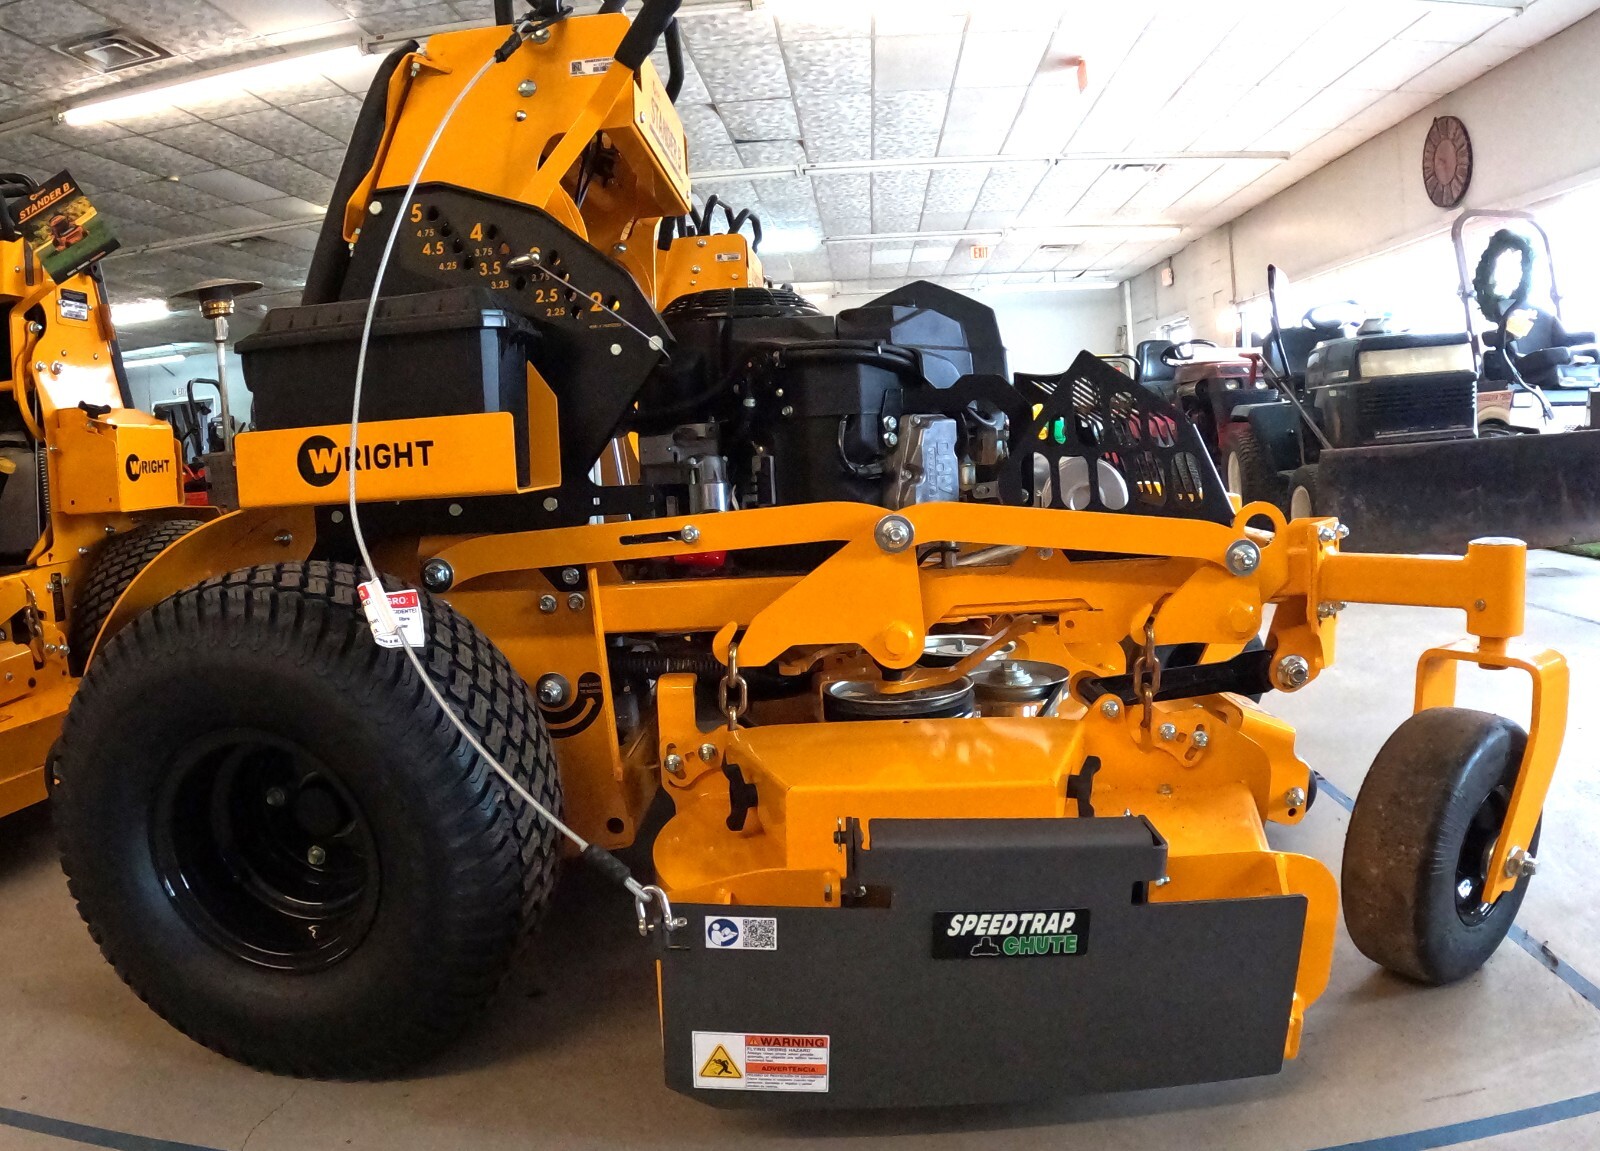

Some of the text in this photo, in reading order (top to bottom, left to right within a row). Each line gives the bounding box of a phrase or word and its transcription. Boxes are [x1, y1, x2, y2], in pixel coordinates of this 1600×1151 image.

[19, 187, 61, 220] STANDER
[62, 182, 70, 193] B
[410, 203, 422, 222] 5
[416, 228, 435, 238] 4.75
[469, 222, 483, 242] 4
[422, 241, 444, 255] 4.5
[474, 247, 493, 257] 3.75
[973, 246, 988, 259] EXIT
[438, 261, 457, 271] 4.25
[479, 261, 501, 276] 3.5
[490, 280, 510, 290] 3.25
[535, 288, 558, 303] 2.5
[590, 291, 603, 312] 2
[546, 307, 565, 317] 2.25
[126, 454, 170, 482] WRIGHT
[297, 435, 434, 487] WRIGHT
[947, 912, 1076, 936] SPEEDTRAP
[1003, 935, 1078, 956] CHUTE
[760, 1037, 824, 1048] WARNING
